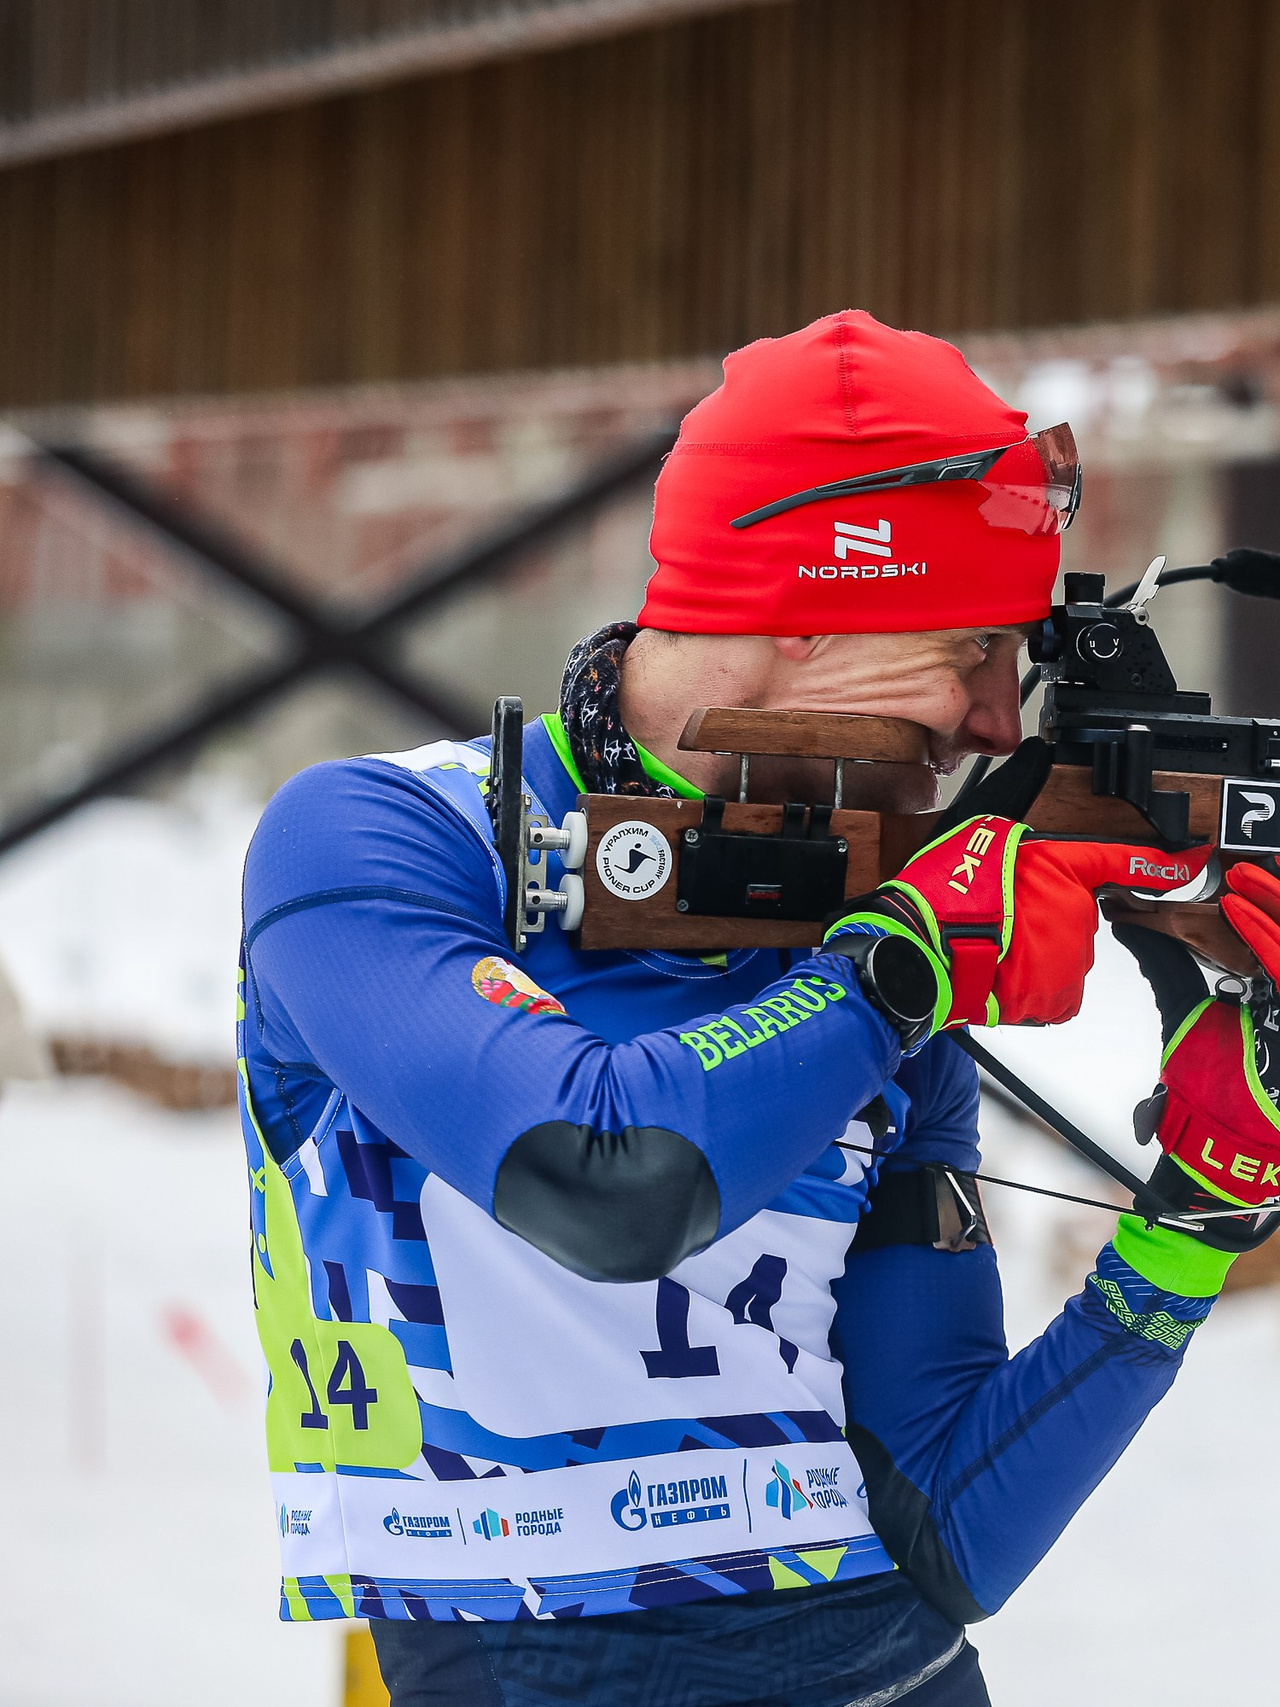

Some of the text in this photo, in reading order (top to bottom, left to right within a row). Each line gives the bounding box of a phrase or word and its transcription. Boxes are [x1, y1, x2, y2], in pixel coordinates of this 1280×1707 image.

[798, 562, 927, 579] NORDSKI
[602, 857, 656, 893] PIONER CUP
[679, 976, 847, 1072] BELARUS
[290, 1338, 378, 1430] 14
[647, 1475, 728, 1508] ГАЗПРОМ
[811, 1488, 849, 1509] ГОРОД
[401, 1515, 451, 1528] ГАЗПРОМ
[515, 1507, 564, 1524] РОДНЫЕ
[653, 1506, 728, 1526] НЕФТЬ
[516, 1521, 562, 1537] ГОРОДА
